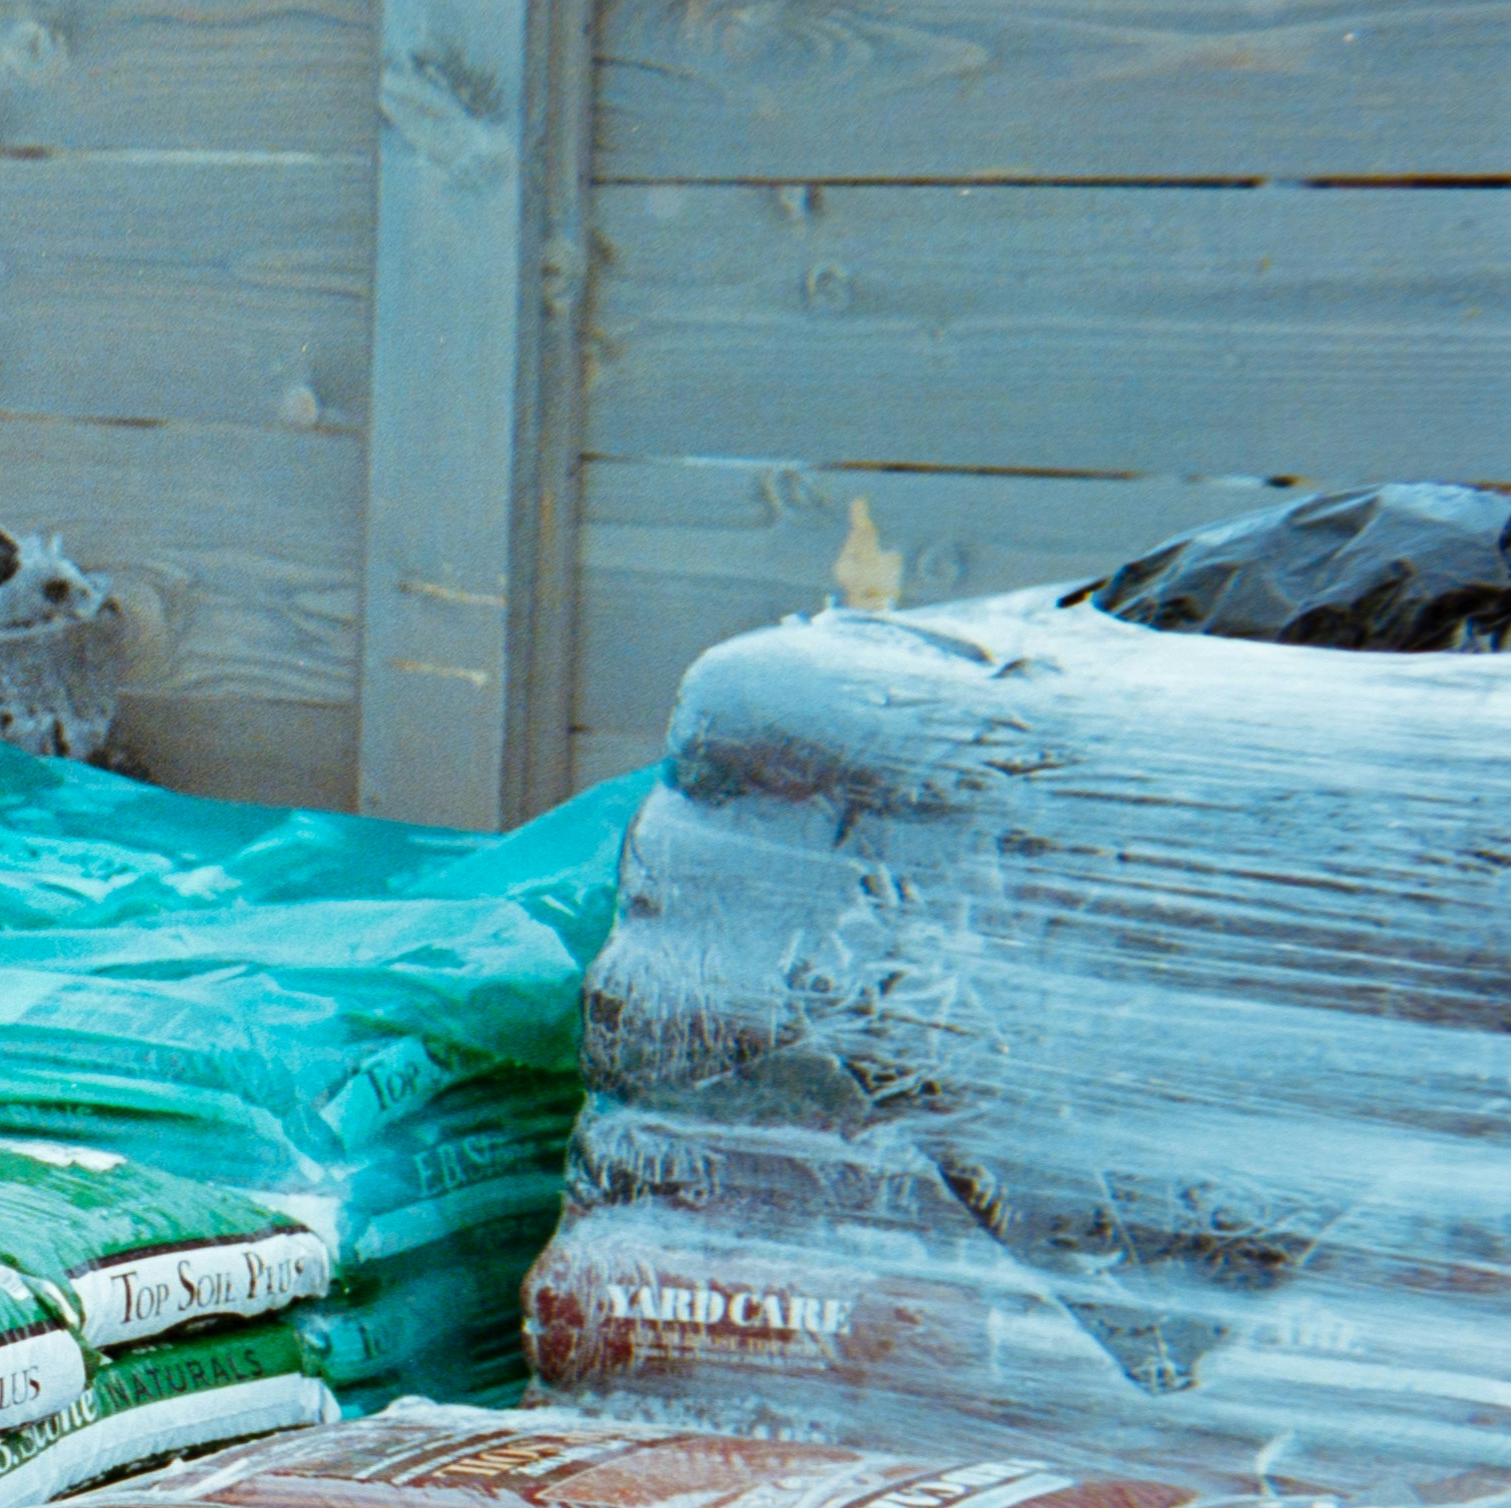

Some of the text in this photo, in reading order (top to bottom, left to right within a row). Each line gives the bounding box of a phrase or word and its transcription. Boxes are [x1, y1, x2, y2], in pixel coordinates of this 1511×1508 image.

[111, 1270, 169, 1324] TOP
[178, 1260, 237, 1311] SOIL
[104, 1350, 263, 1410] NATURALS
